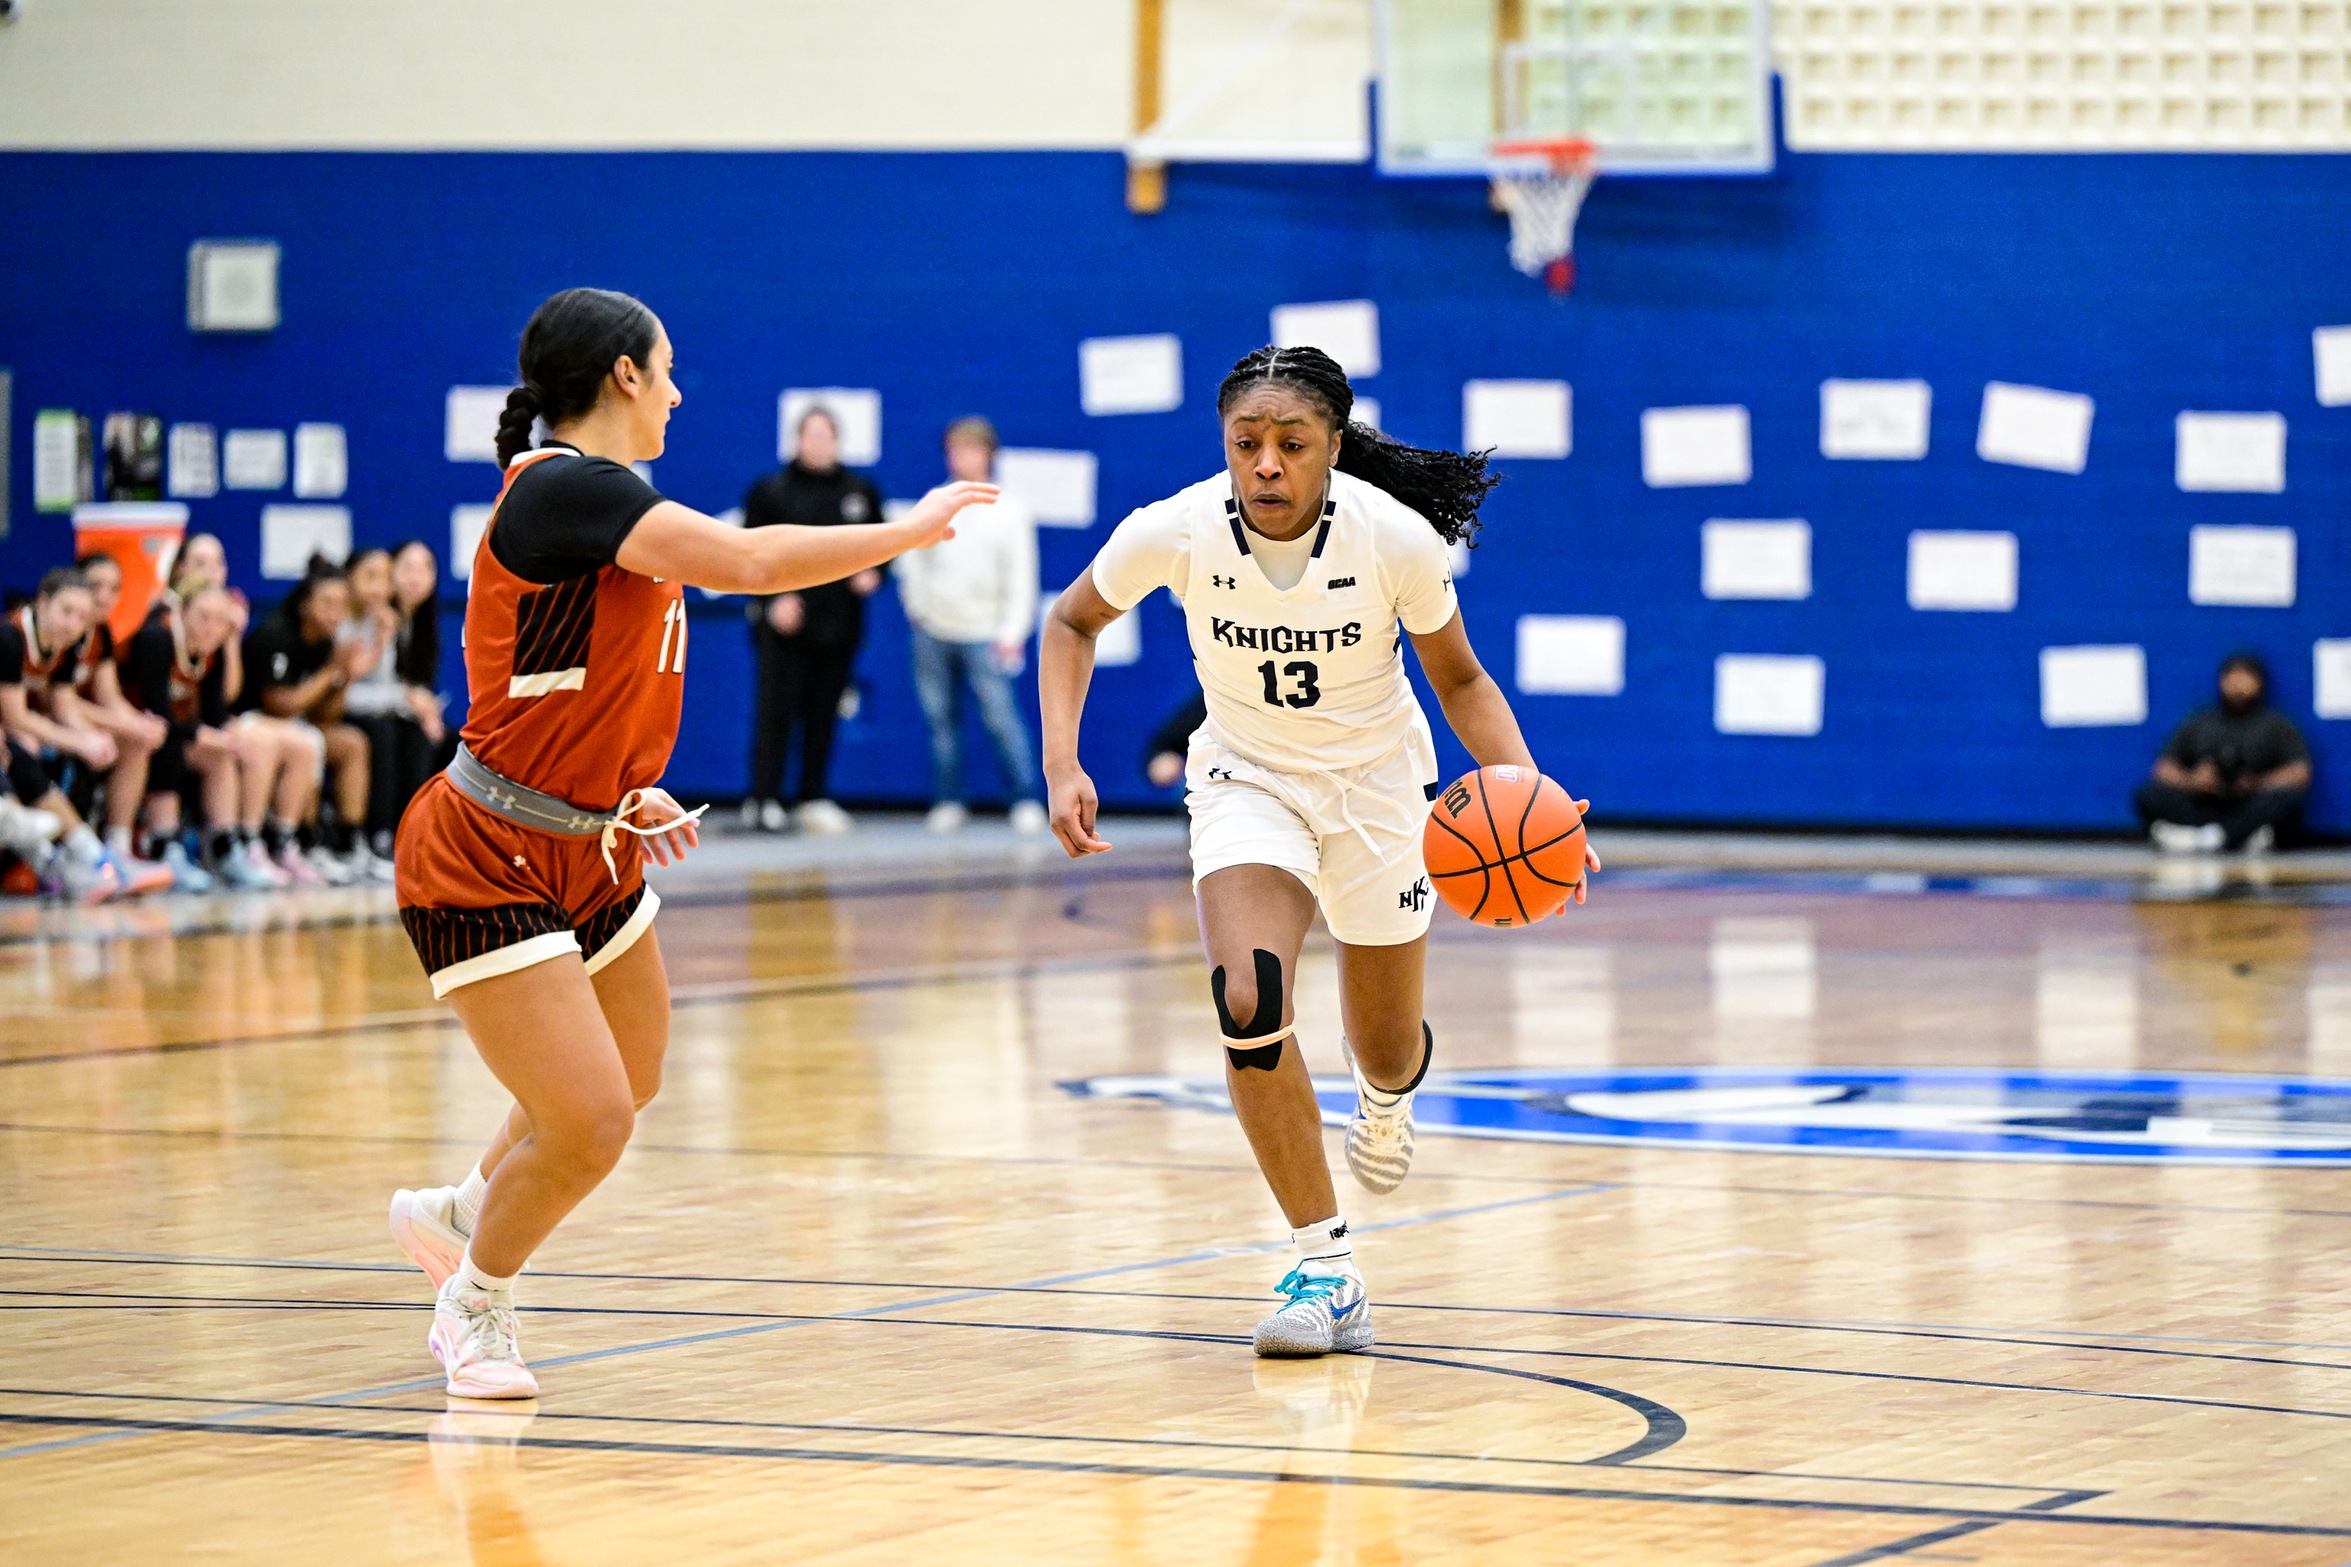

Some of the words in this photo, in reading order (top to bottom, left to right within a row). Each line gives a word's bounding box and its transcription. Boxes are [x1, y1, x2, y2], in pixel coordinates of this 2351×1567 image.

[657, 598, 685, 674] 11
[1211, 616, 1362, 654] KNIGHTS
[1257, 660, 1321, 709] 13
